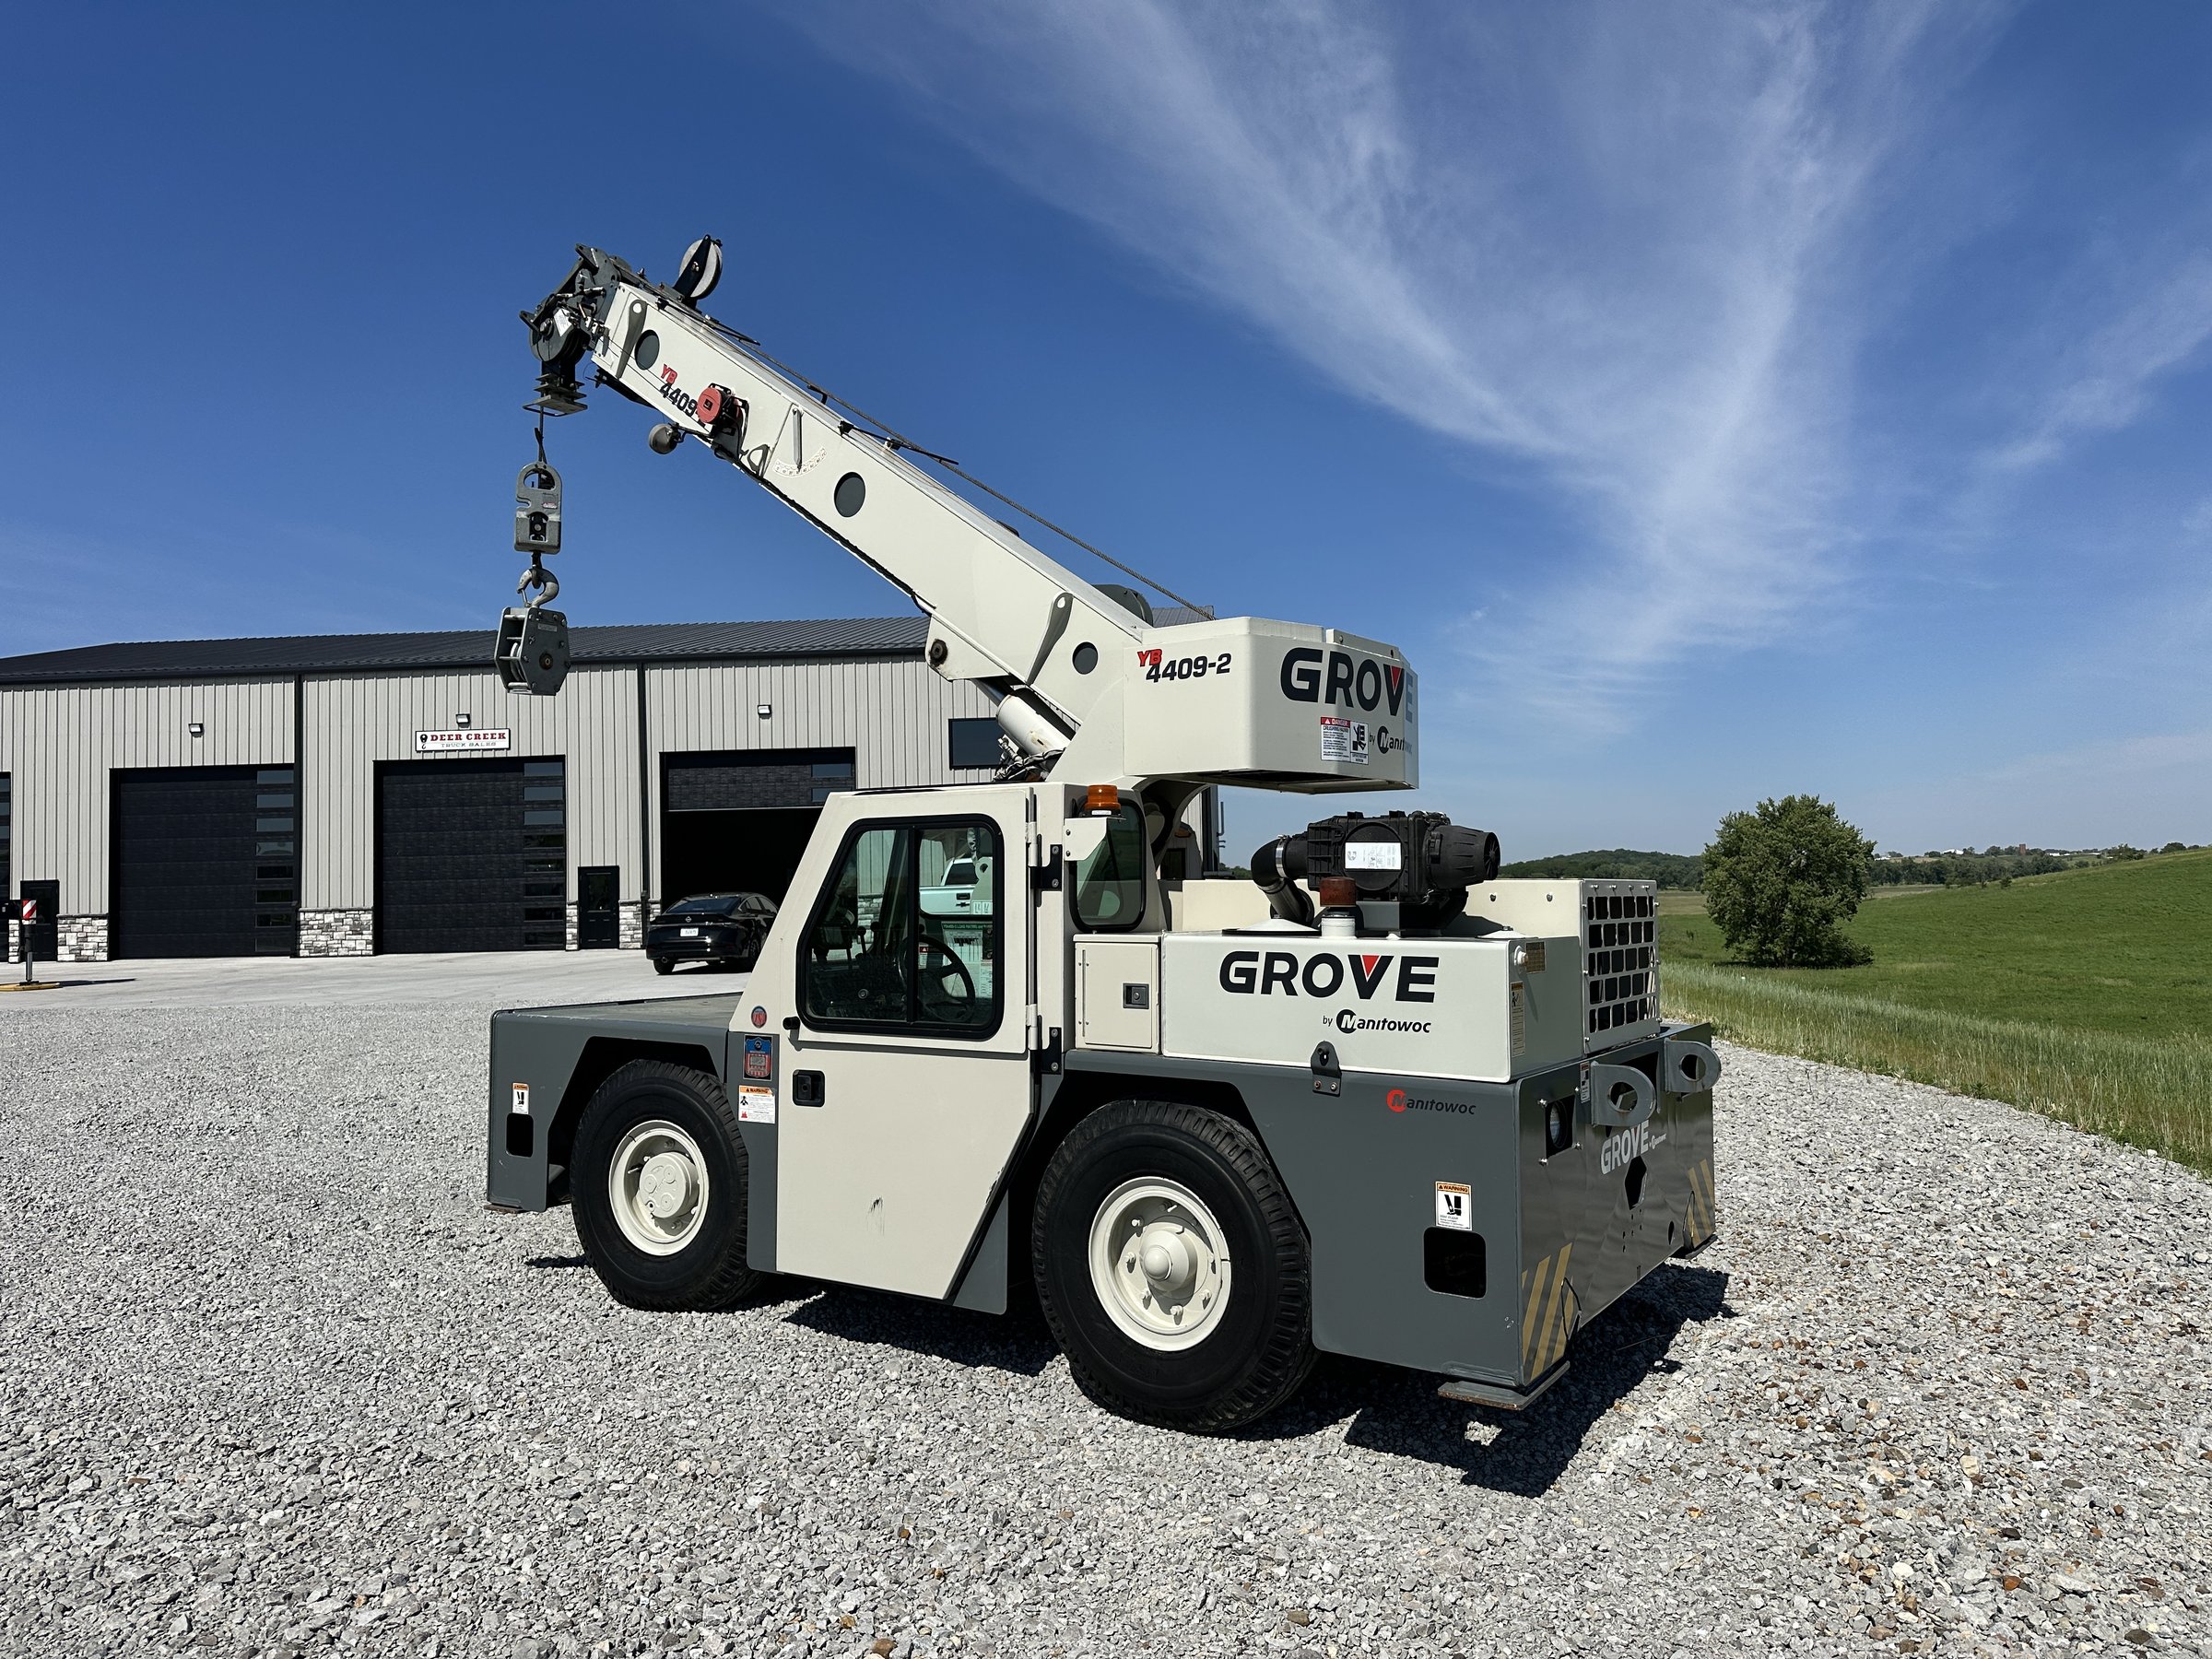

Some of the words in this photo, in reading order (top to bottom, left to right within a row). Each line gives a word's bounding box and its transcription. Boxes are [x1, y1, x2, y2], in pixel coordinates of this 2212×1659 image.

[660, 363, 678, 384] YB
[1137, 648, 1162, 668] YB
[1146, 653, 1232, 683] 4409-2
[1280, 646, 1414, 724] GROVE
[1369, 732, 1376, 746] by
[1219, 950, 1440, 1004] GROVE
[1323, 1015, 1334, 1027] by
[1335, 1008, 1432, 1034] Manitowoc
[1386, 1089, 1477, 1115] Manitowoc
[1601, 1120, 1649, 1174] GROVE
